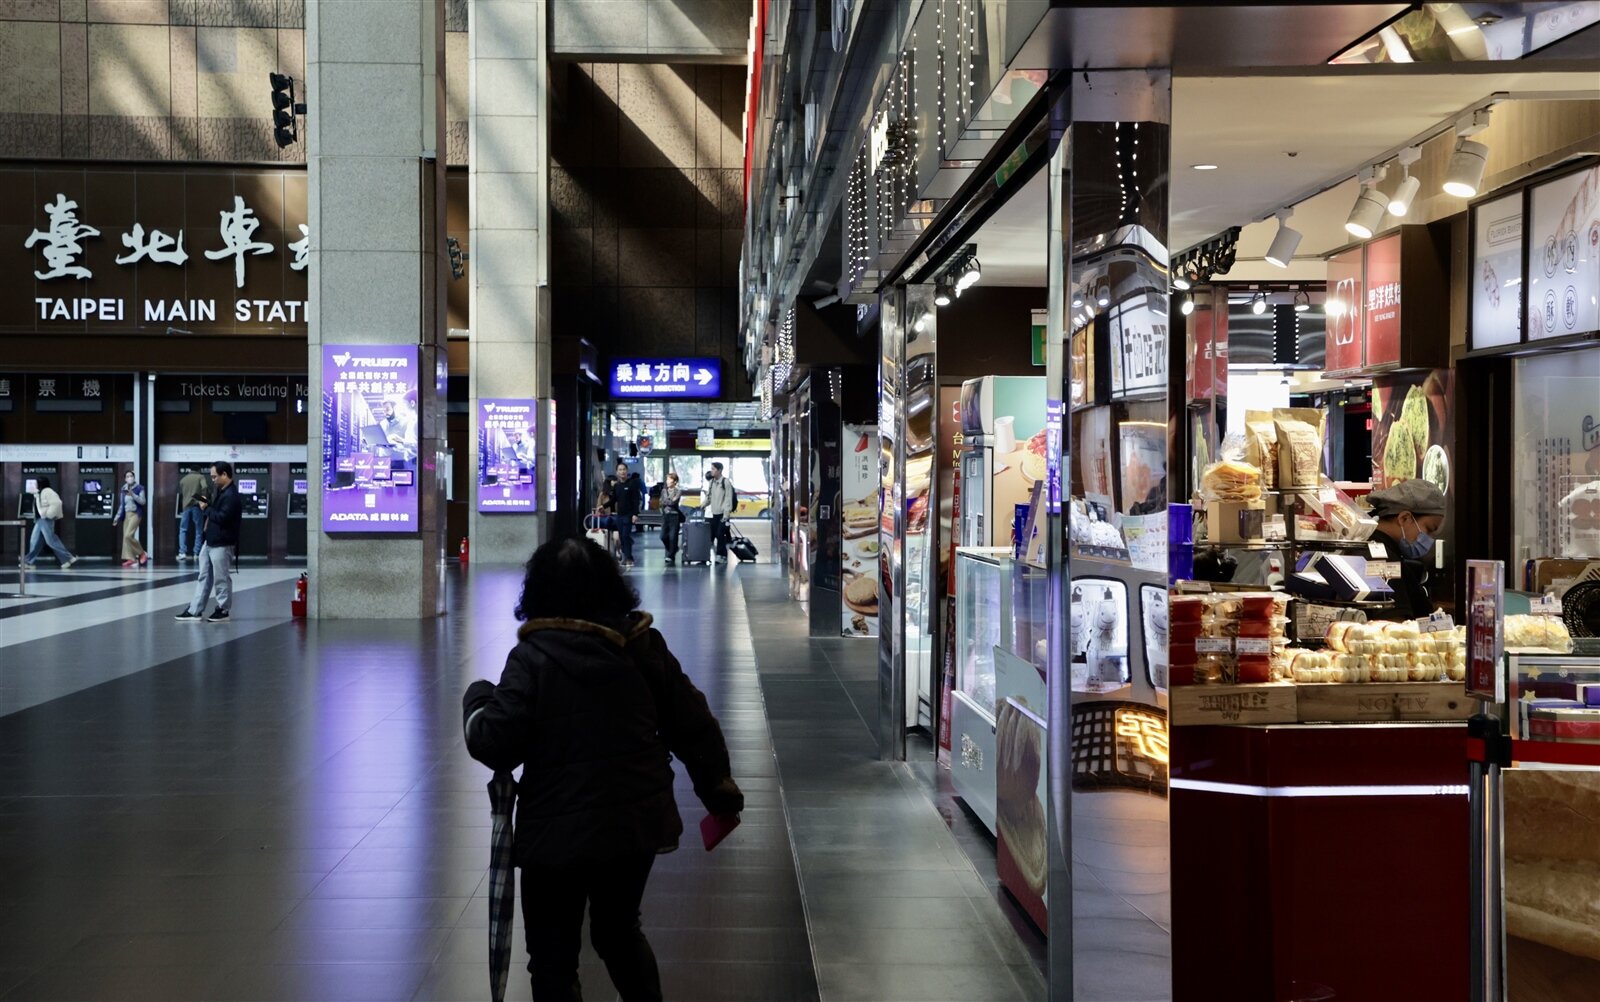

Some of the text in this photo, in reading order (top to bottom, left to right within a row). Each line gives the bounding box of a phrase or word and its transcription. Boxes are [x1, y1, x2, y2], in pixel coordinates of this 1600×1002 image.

[24, 193, 308, 288] 臺北車
[36, 298, 124, 321] TAIPEI
[145, 299, 216, 322] MAIN
[616, 362, 690, 382] 乘車方向
[181, 382, 230, 396] Tickets
[237, 382, 287, 398] Vending
[620, 384, 652, 393] BOARDING
[329, 512, 369, 521] ADATA
